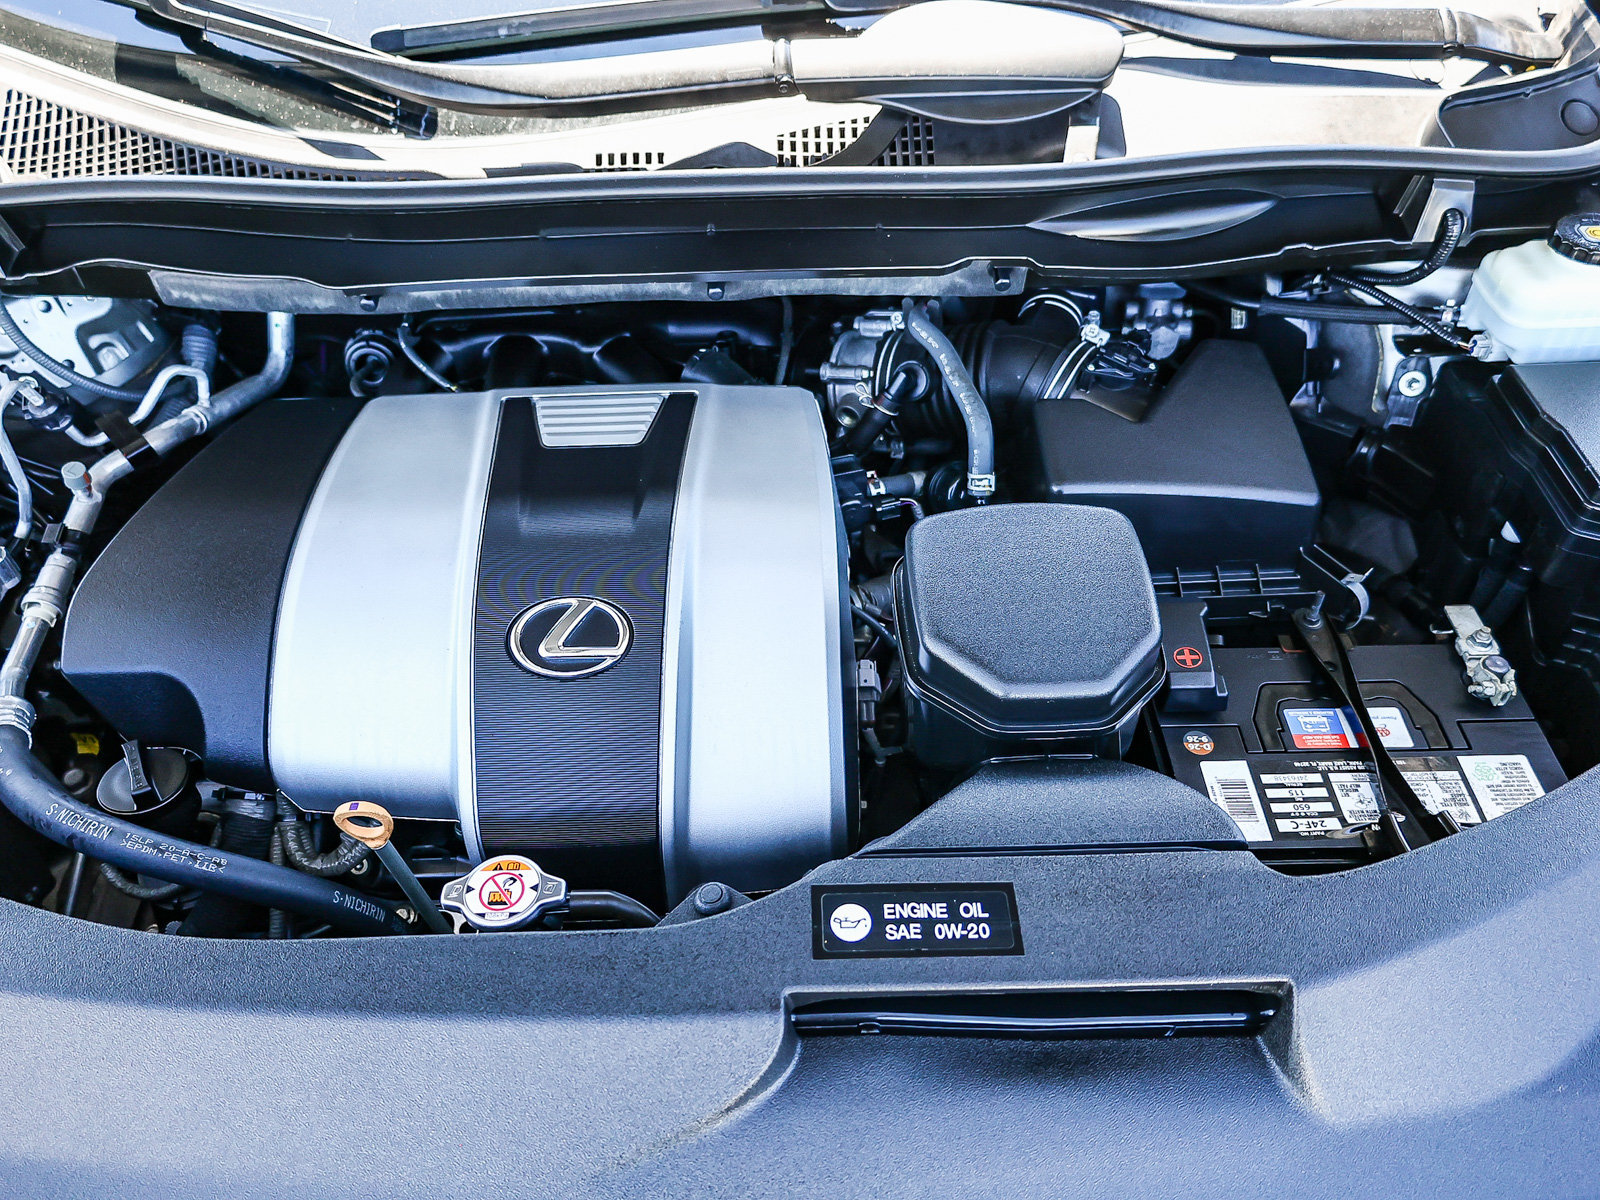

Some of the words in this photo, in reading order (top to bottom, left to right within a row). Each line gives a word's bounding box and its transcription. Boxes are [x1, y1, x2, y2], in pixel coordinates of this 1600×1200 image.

[1290, 821, 1327, 829] 24F-C
[883, 902, 948, 919] ENGINE
[959, 902, 989, 918] OIL
[885, 924, 922, 940] SAE
[934, 923, 990, 939] 0W-20
